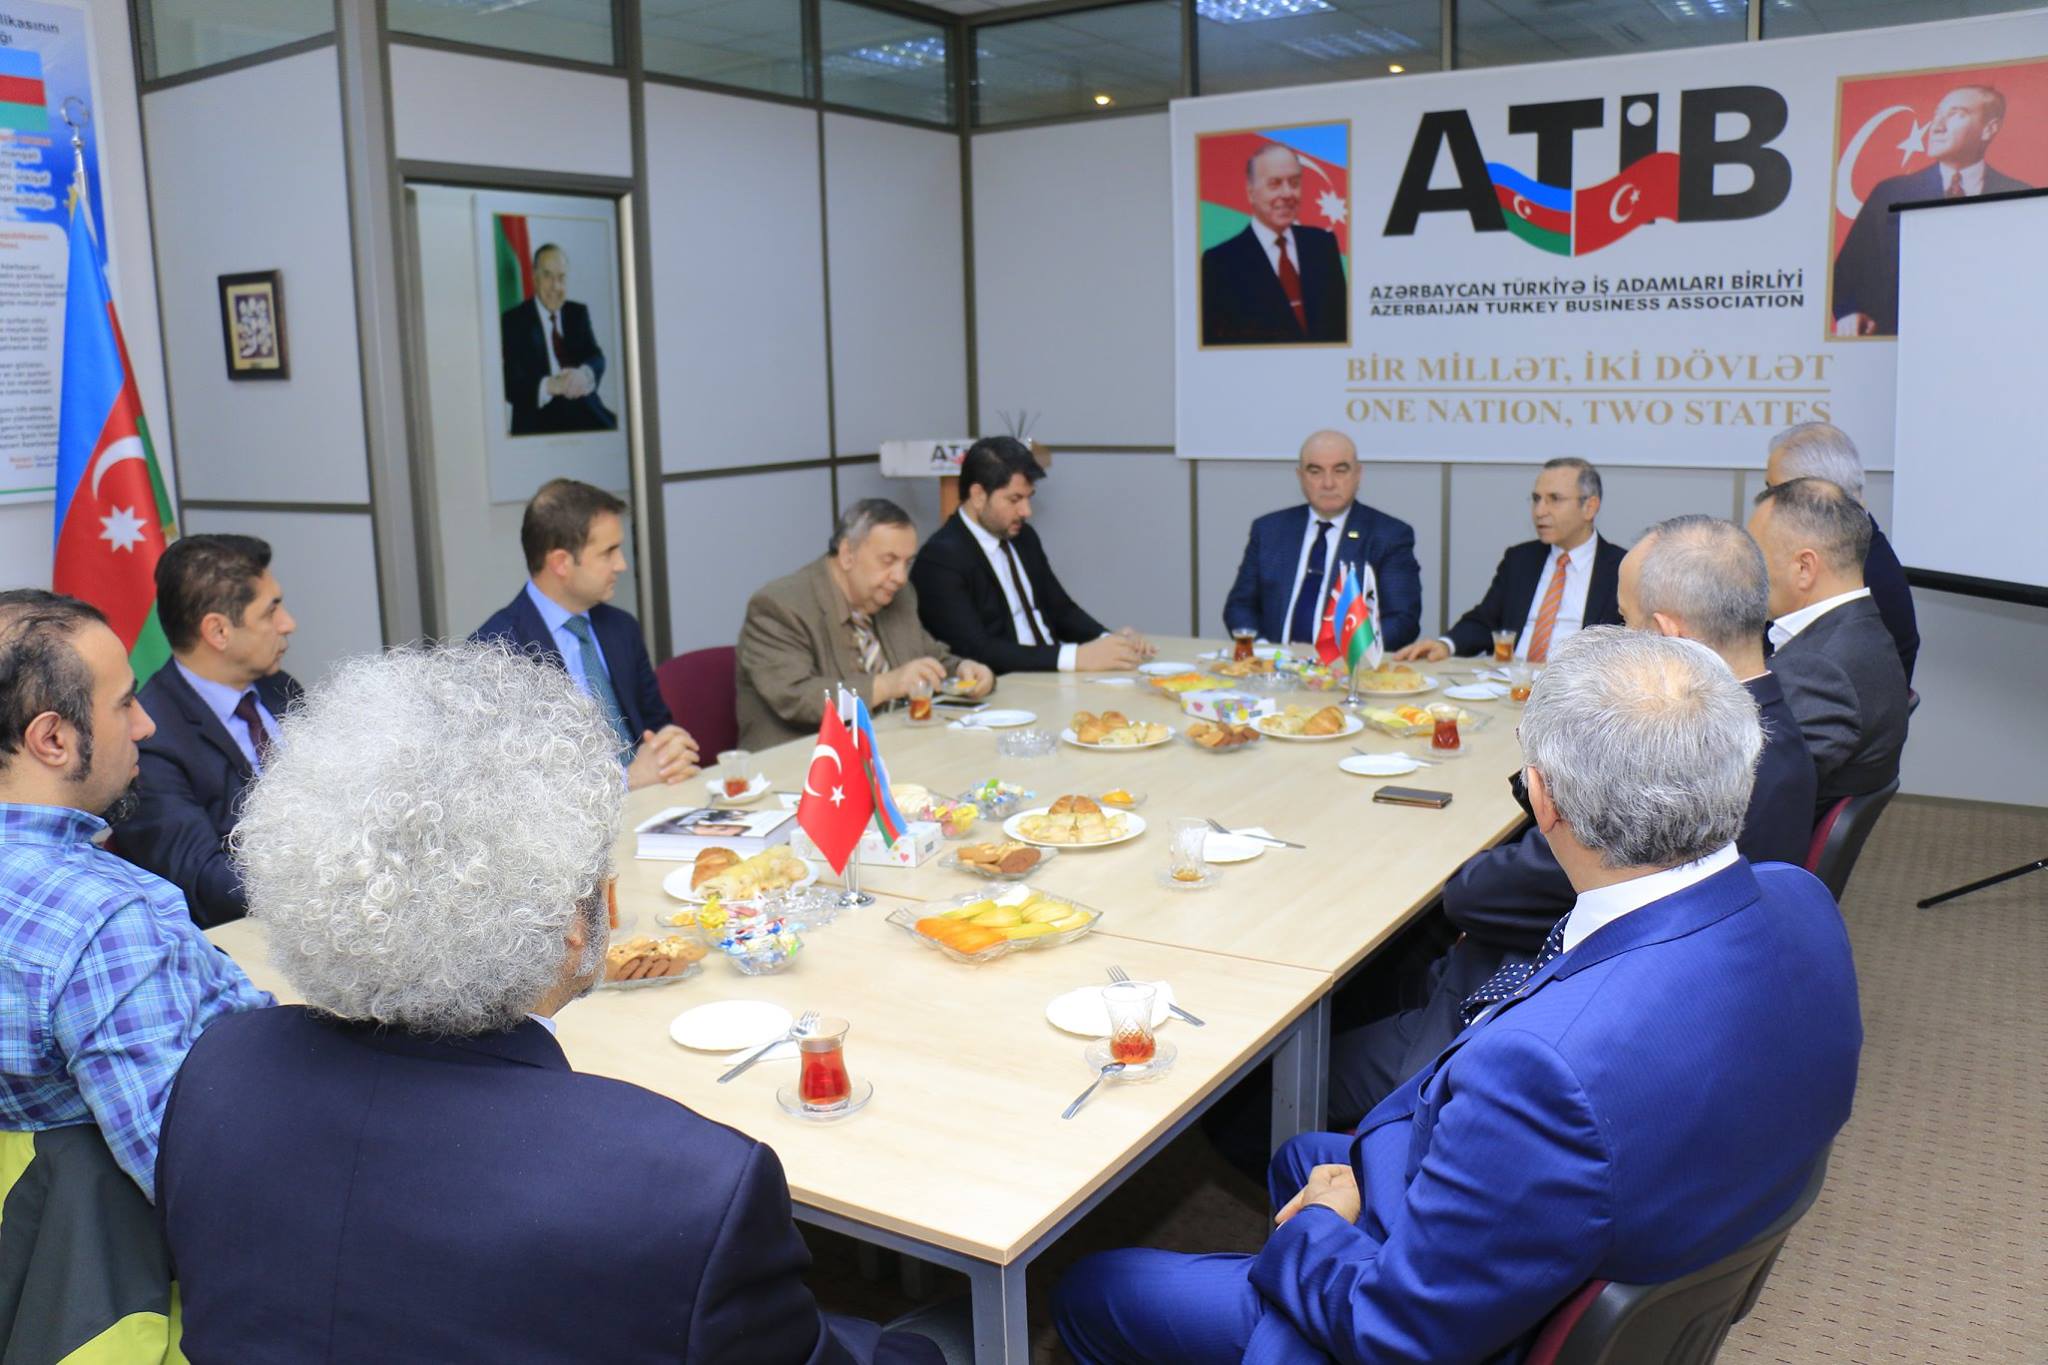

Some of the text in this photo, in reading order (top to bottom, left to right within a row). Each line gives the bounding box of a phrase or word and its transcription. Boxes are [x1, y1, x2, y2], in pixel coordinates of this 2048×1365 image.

[1370, 283, 1496, 300] AZƏRBAYCAN
[1503, 275, 1586, 298] TÜRKİYƏ
[1616, 276, 1724, 293] ADAMLARI
[1731, 268, 1804, 290] BİRLİYİ
[1370, 295, 1804, 317] AZERBAIJAN TURKEY BUSINESS ASSOCIATION
[1346, 349, 1834, 384] BİR MİLLƏT, İKİ DÖVLƏT
[1345, 399, 1832, 428] ONE NATION, TWO STATES
